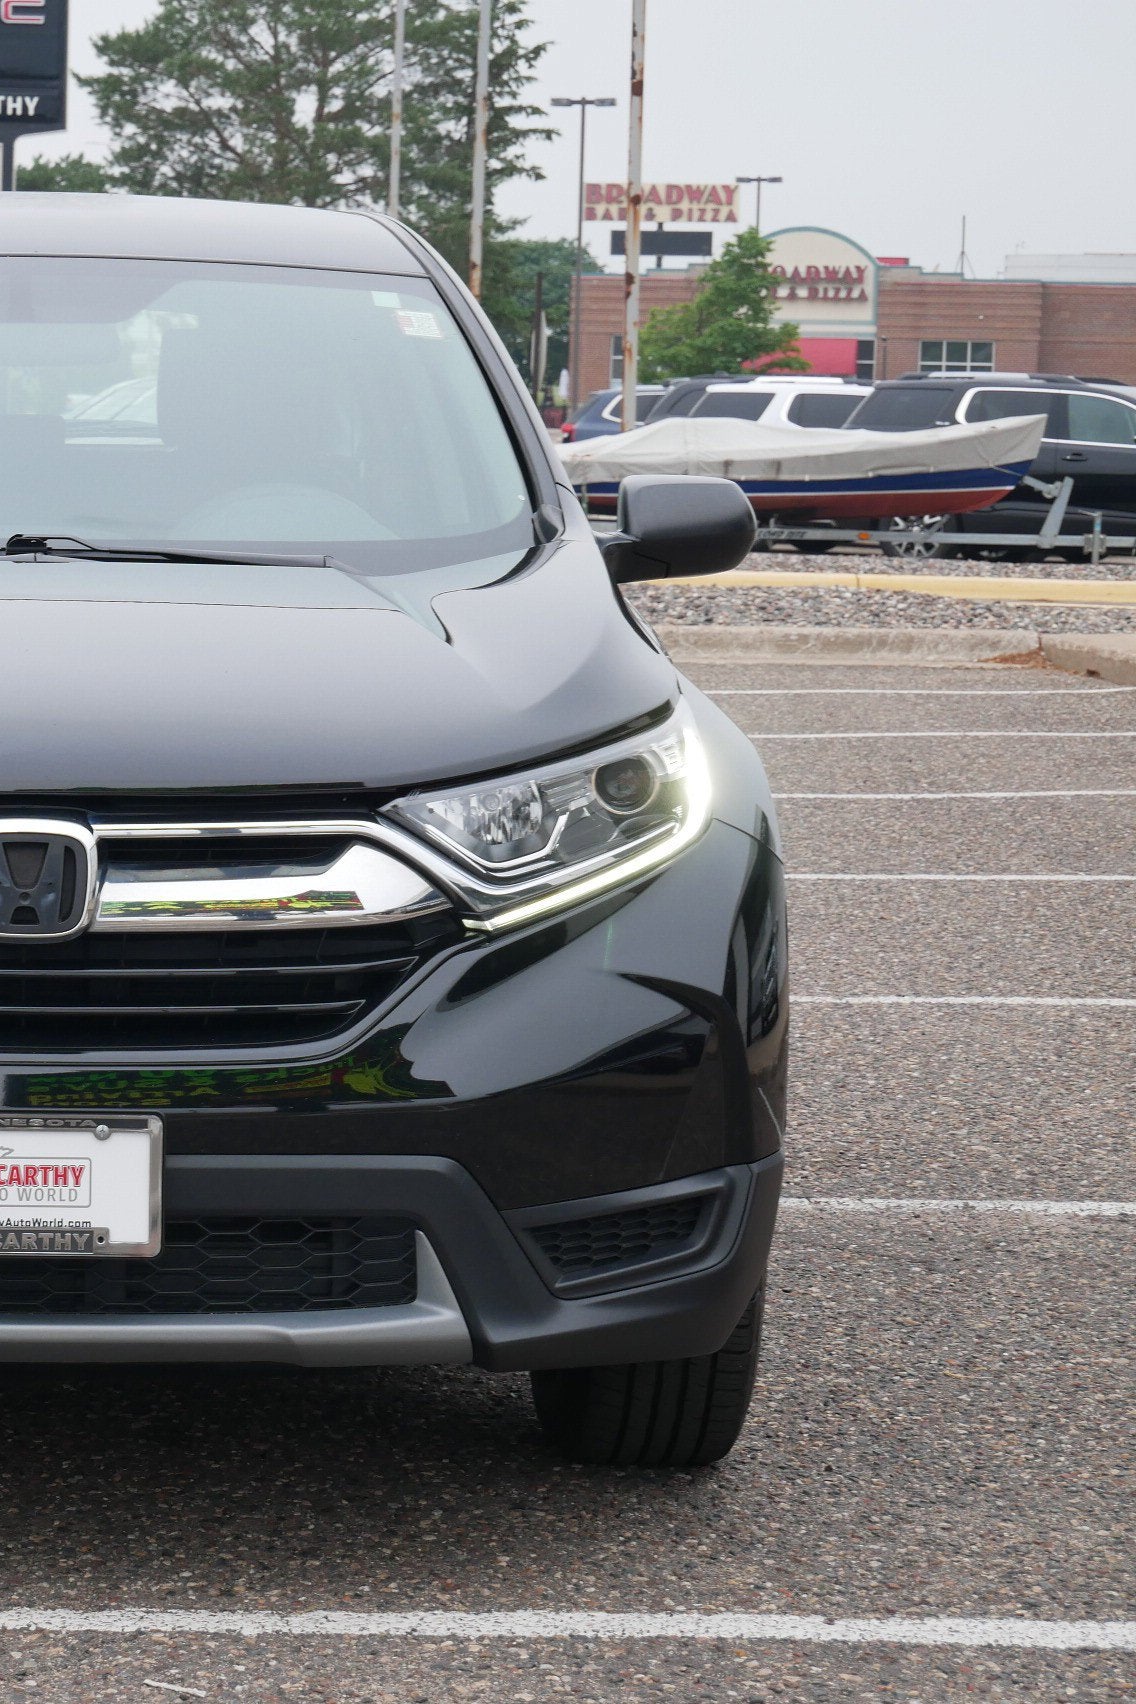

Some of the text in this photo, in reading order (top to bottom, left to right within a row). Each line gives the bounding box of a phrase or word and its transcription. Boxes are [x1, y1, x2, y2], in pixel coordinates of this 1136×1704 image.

[585, 183, 739, 205] BRADWAY
[644, 208, 656, 221] &
[671, 208, 738, 222] PIZZA
[765, 265, 867, 284] OADWAY
[808, 287, 868, 302] PIZZA
[17, 1188, 78, 1202] WORLD
